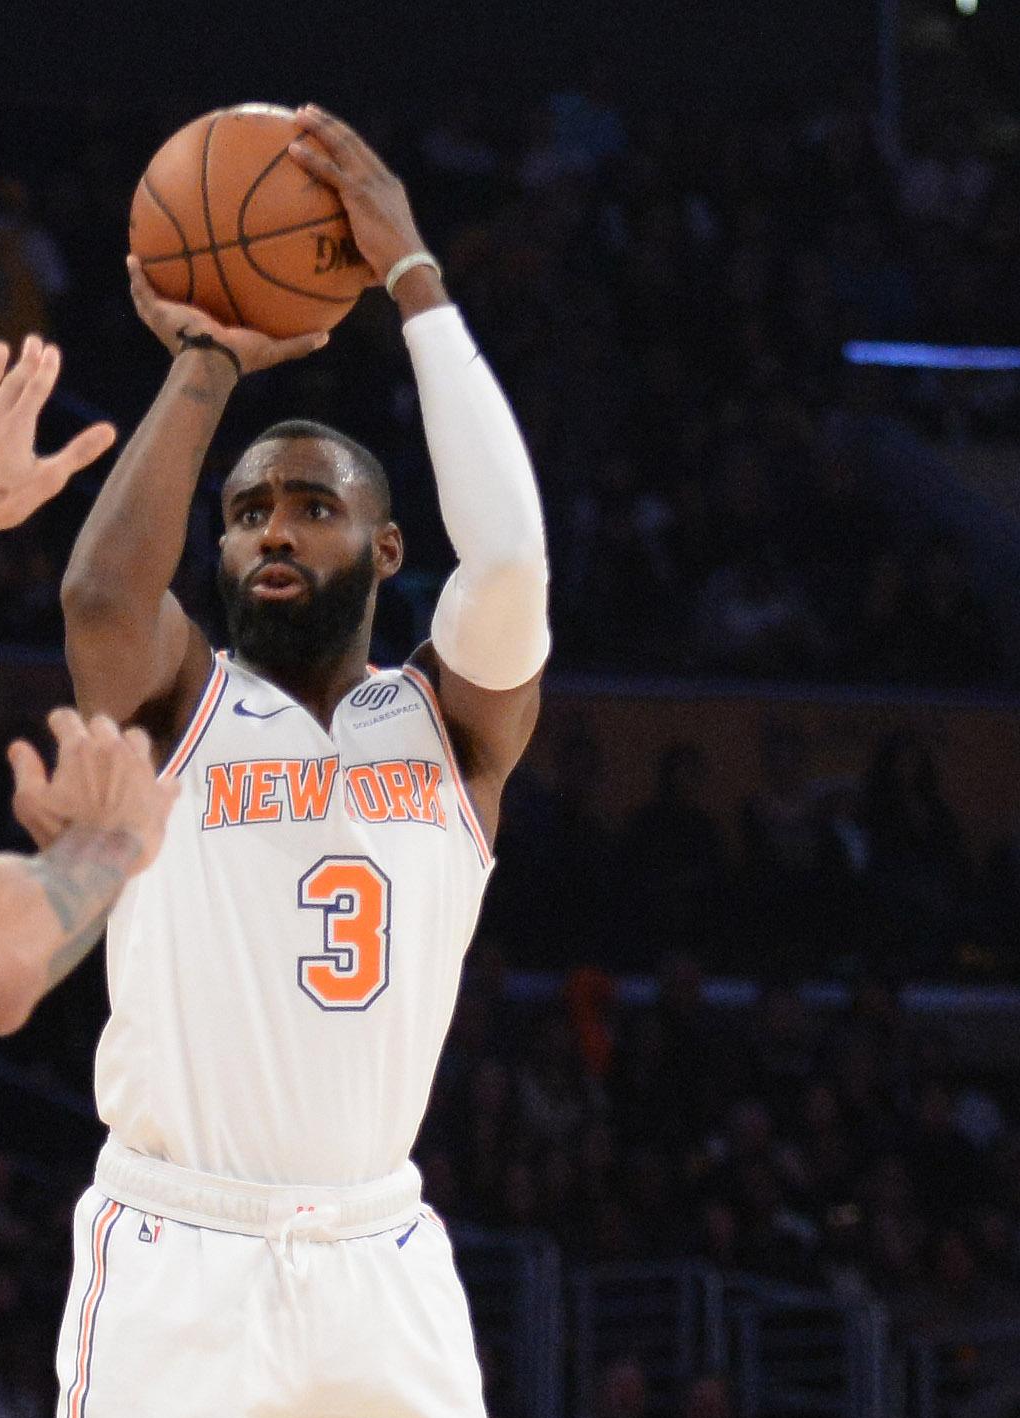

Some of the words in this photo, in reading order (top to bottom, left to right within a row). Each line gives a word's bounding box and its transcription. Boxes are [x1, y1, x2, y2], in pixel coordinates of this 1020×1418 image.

[352, 702, 422, 730] SQUARESPACE
[202, 754, 340, 831] NEW
[343, 759, 447, 831] ORK
[297, 854, 393, 1013] 3
